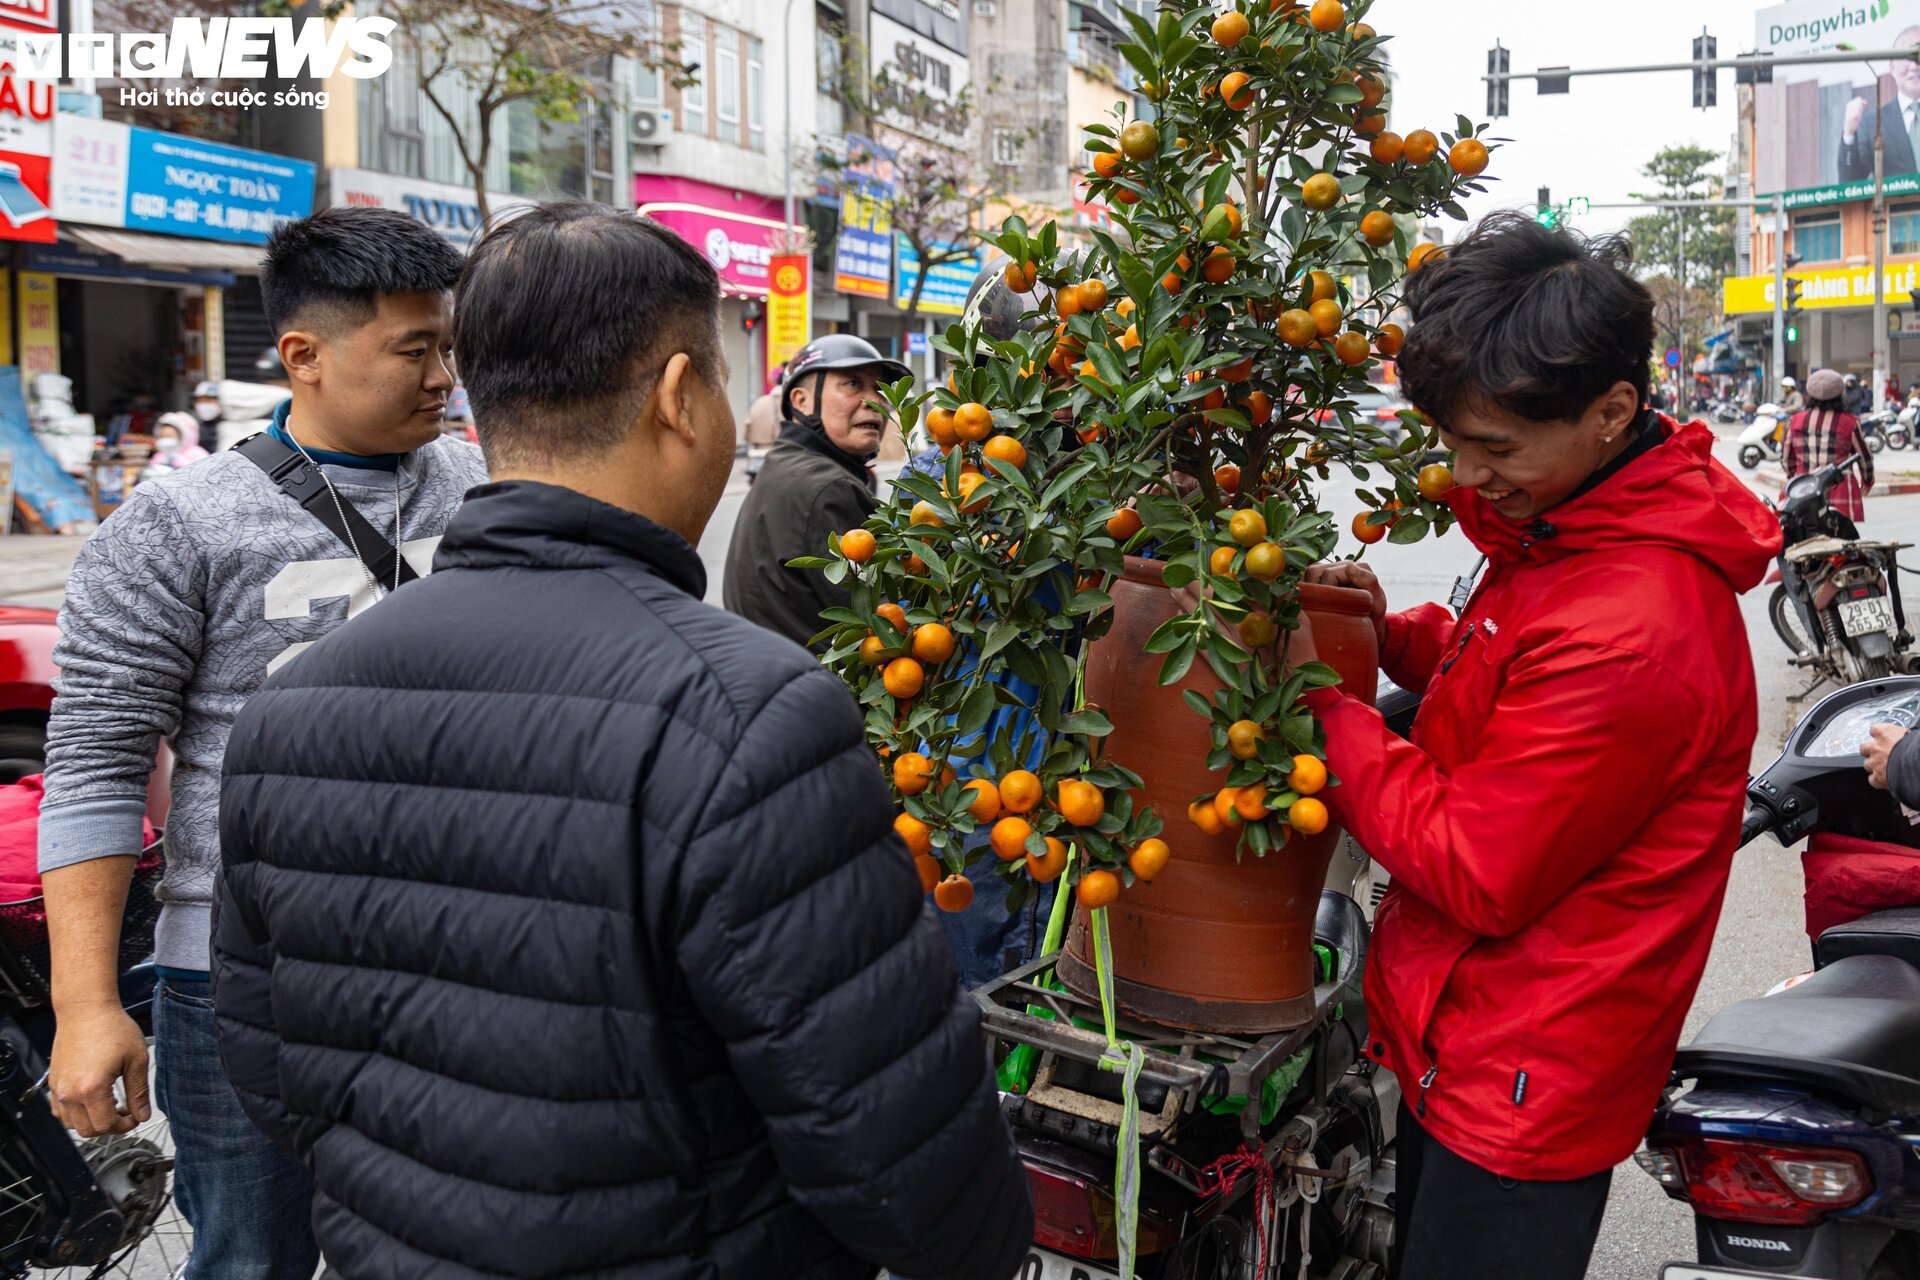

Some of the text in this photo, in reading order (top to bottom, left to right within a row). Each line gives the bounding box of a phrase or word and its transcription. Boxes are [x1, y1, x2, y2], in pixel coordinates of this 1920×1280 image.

[1770, 7, 1866, 46] Dongwha
[70, 136, 118, 167] 211
[1802, 274, 1849, 301] HÀNG
[1895, 264, 1917, 294] LẺ
[1726, 1235, 1792, 1252] HONDA
